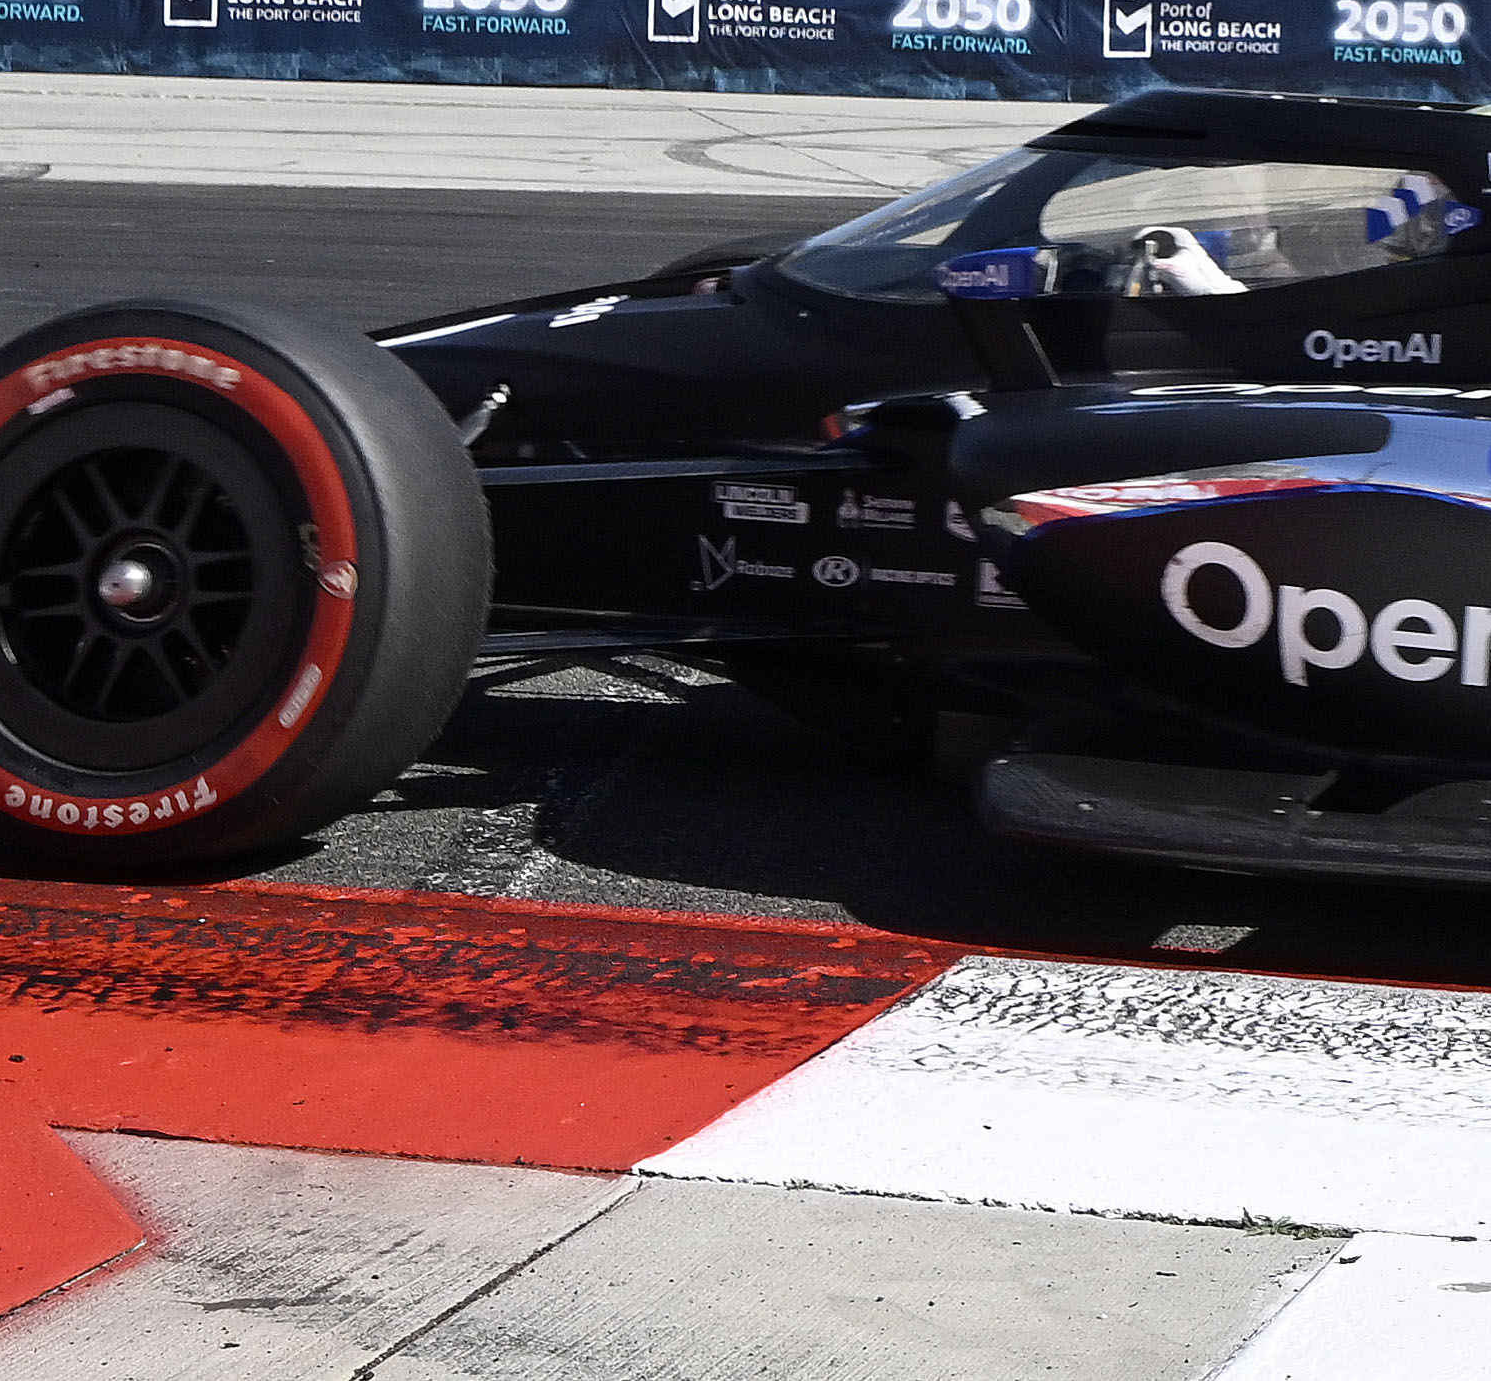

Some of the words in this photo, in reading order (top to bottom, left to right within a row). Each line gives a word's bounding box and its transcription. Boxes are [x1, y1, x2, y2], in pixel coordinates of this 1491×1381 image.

[228, 8, 252, 20] THE
[257, 9, 290, 21] PORT
[292, 10, 310, 21] OF
[313, 10, 360, 22] CHOICE
[708, 5, 761, 22] LONG
[770, 7, 836, 25] BEACH
[1160, 2, 1194, 17] Port
[1196, 3, 1212, 20] of
[1160, 21, 1211, 36] LONG
[1219, 22, 1280, 38] BEACH
[1335, 0, 1465, 43] 2050
[736, 27, 767, 38] PORT
[770, 28, 786, 38] OF
[789, 28, 834, 40] CHOICE
[1161, 40, 1183, 51] THE
[1187, 41, 1217, 52] PORT
[1220, 42, 1235, 53] OF
[1238, 42, 1279, 54] CHOICE
[1305, 332, 1441, 367] OpenAI
[5, 776, 219, 830] Firestone
